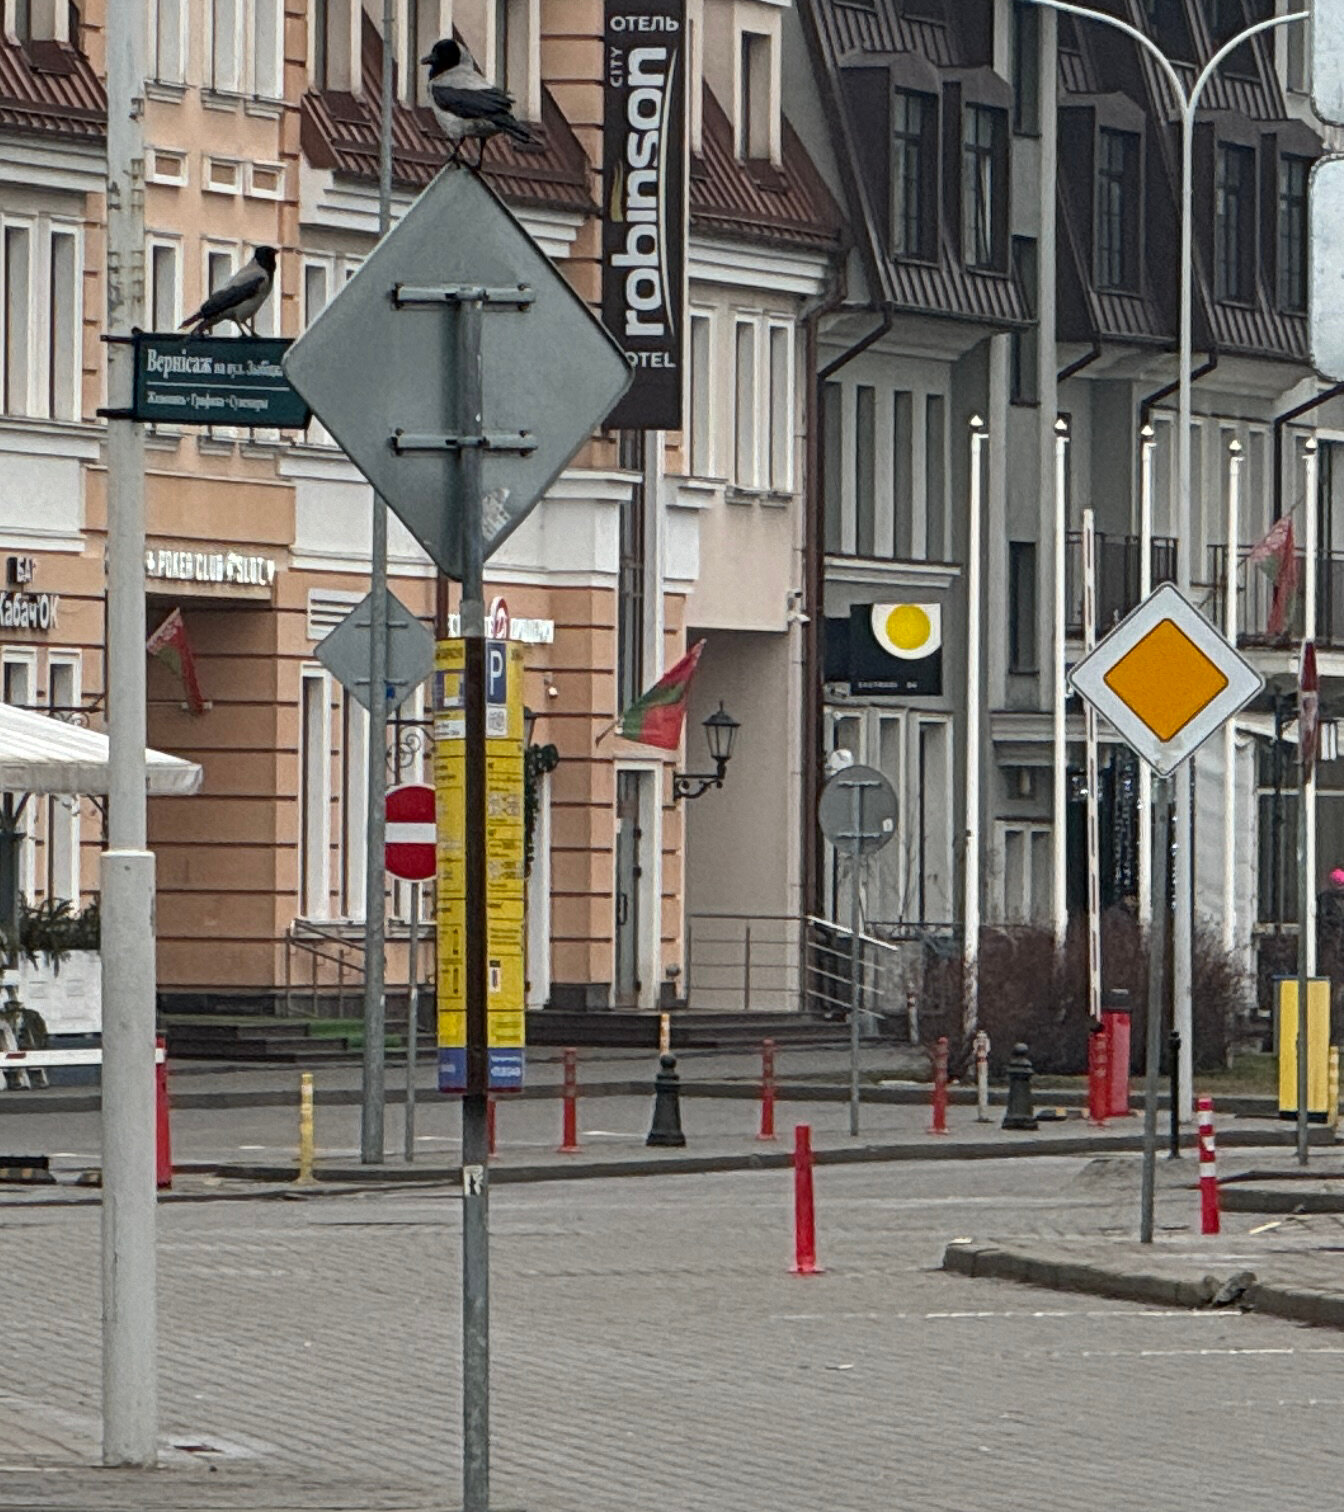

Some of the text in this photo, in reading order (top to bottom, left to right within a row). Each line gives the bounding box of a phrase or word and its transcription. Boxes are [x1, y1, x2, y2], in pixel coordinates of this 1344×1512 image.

[610, 15, 680, 32] ОТЕЛЬ
[610, 46, 624, 87] CITY
[611, 47, 667, 336] robinson
[147, 349, 212, 379] Вернісаж
[625, 352, 676, 368] OTEL
[490, 650, 503, 696] P
